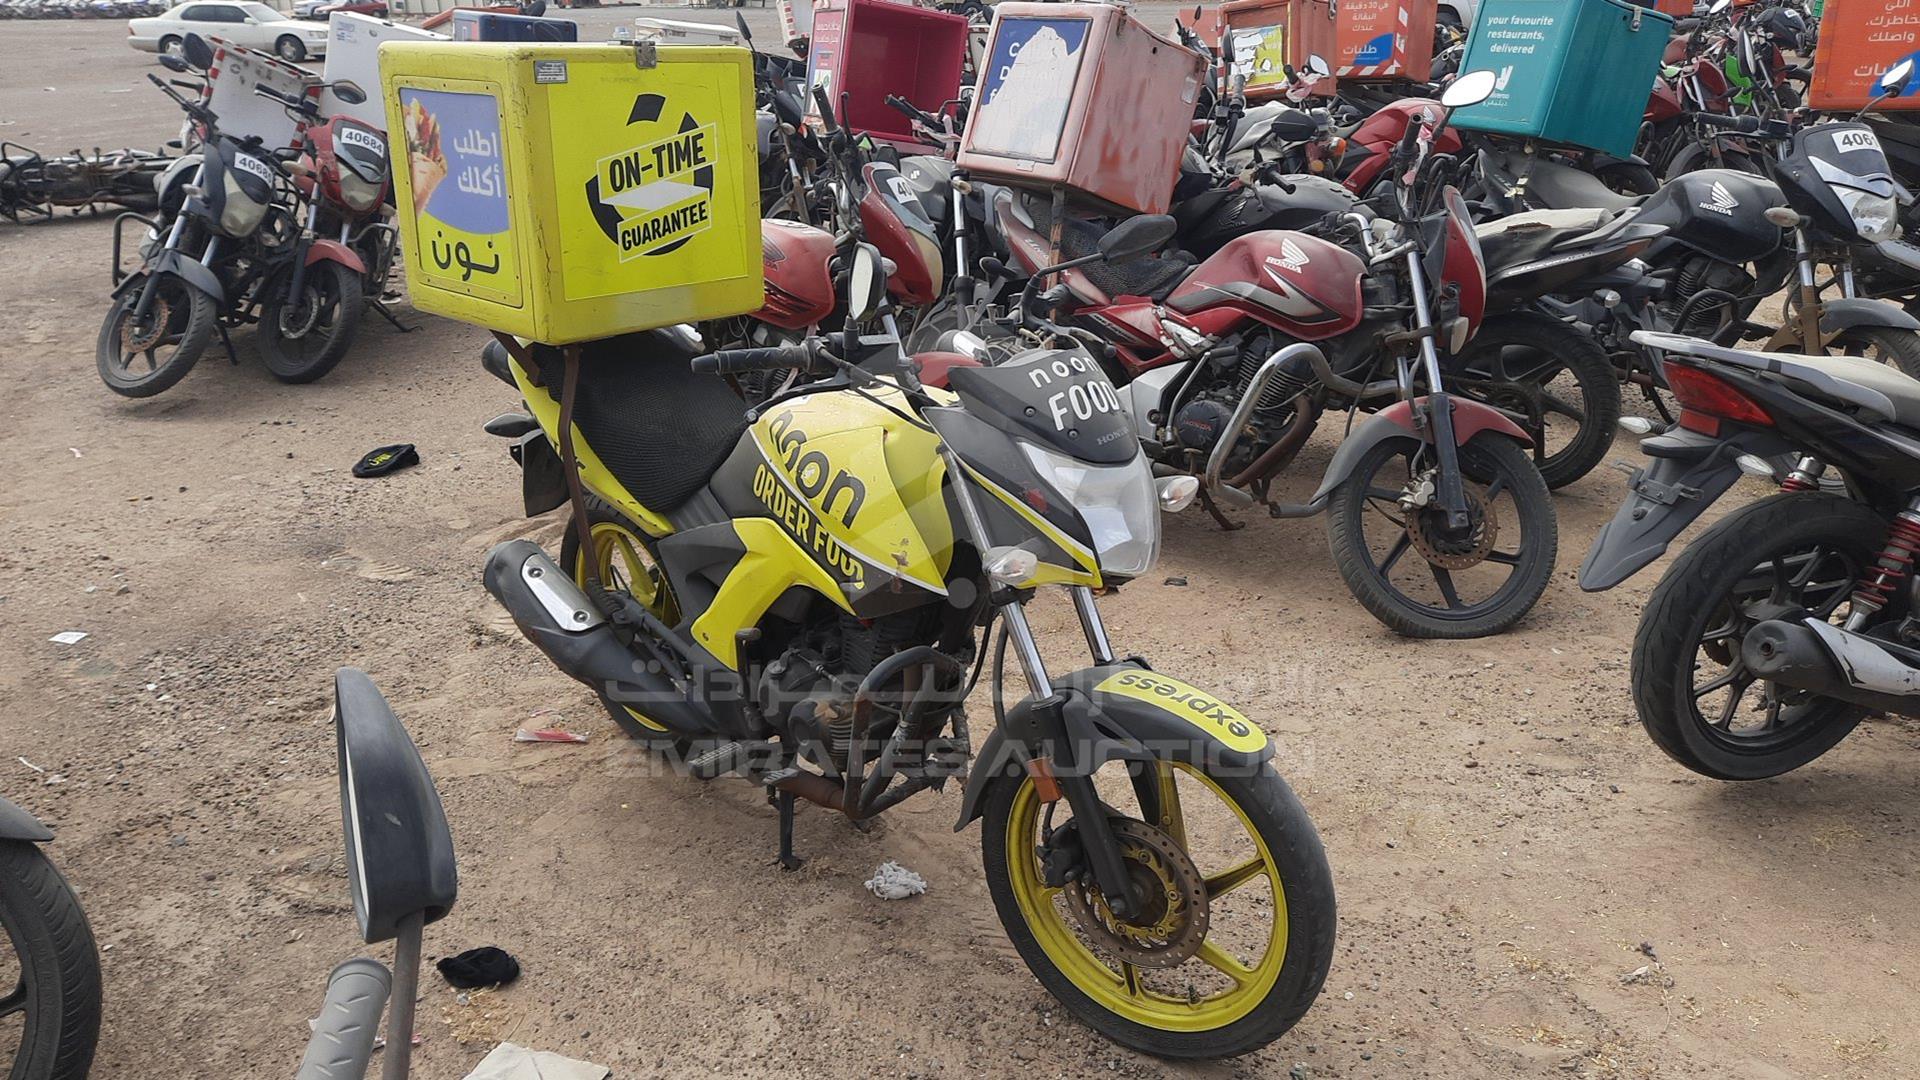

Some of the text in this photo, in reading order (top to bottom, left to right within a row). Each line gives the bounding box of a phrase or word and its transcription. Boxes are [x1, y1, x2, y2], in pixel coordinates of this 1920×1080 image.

[1487, 15, 1554, 26] your favourite
[1487, 30, 1545, 41] restaurants,
[1343, 44, 1377, 57] طلبات
[1490, 44, 1535, 54] delivered
[344, 130, 383, 154] 40684
[453, 129, 498, 160] اطلب
[609, 132, 706, 193] ON-TIME
[457, 163, 502, 199] أكلك
[1699, 202, 1733, 216] HONDA
[621, 200, 708, 251] GUARANTEE
[431, 230, 500, 282] نون
[1265, 256, 1302, 274] HONDA
[1028, 356, 1099, 388] noon
[1048, 380, 1120, 431] FOOD
[768, 409, 866, 530] noon
[752, 463, 810, 544] ORDER
[1117, 673, 1251, 738] express
